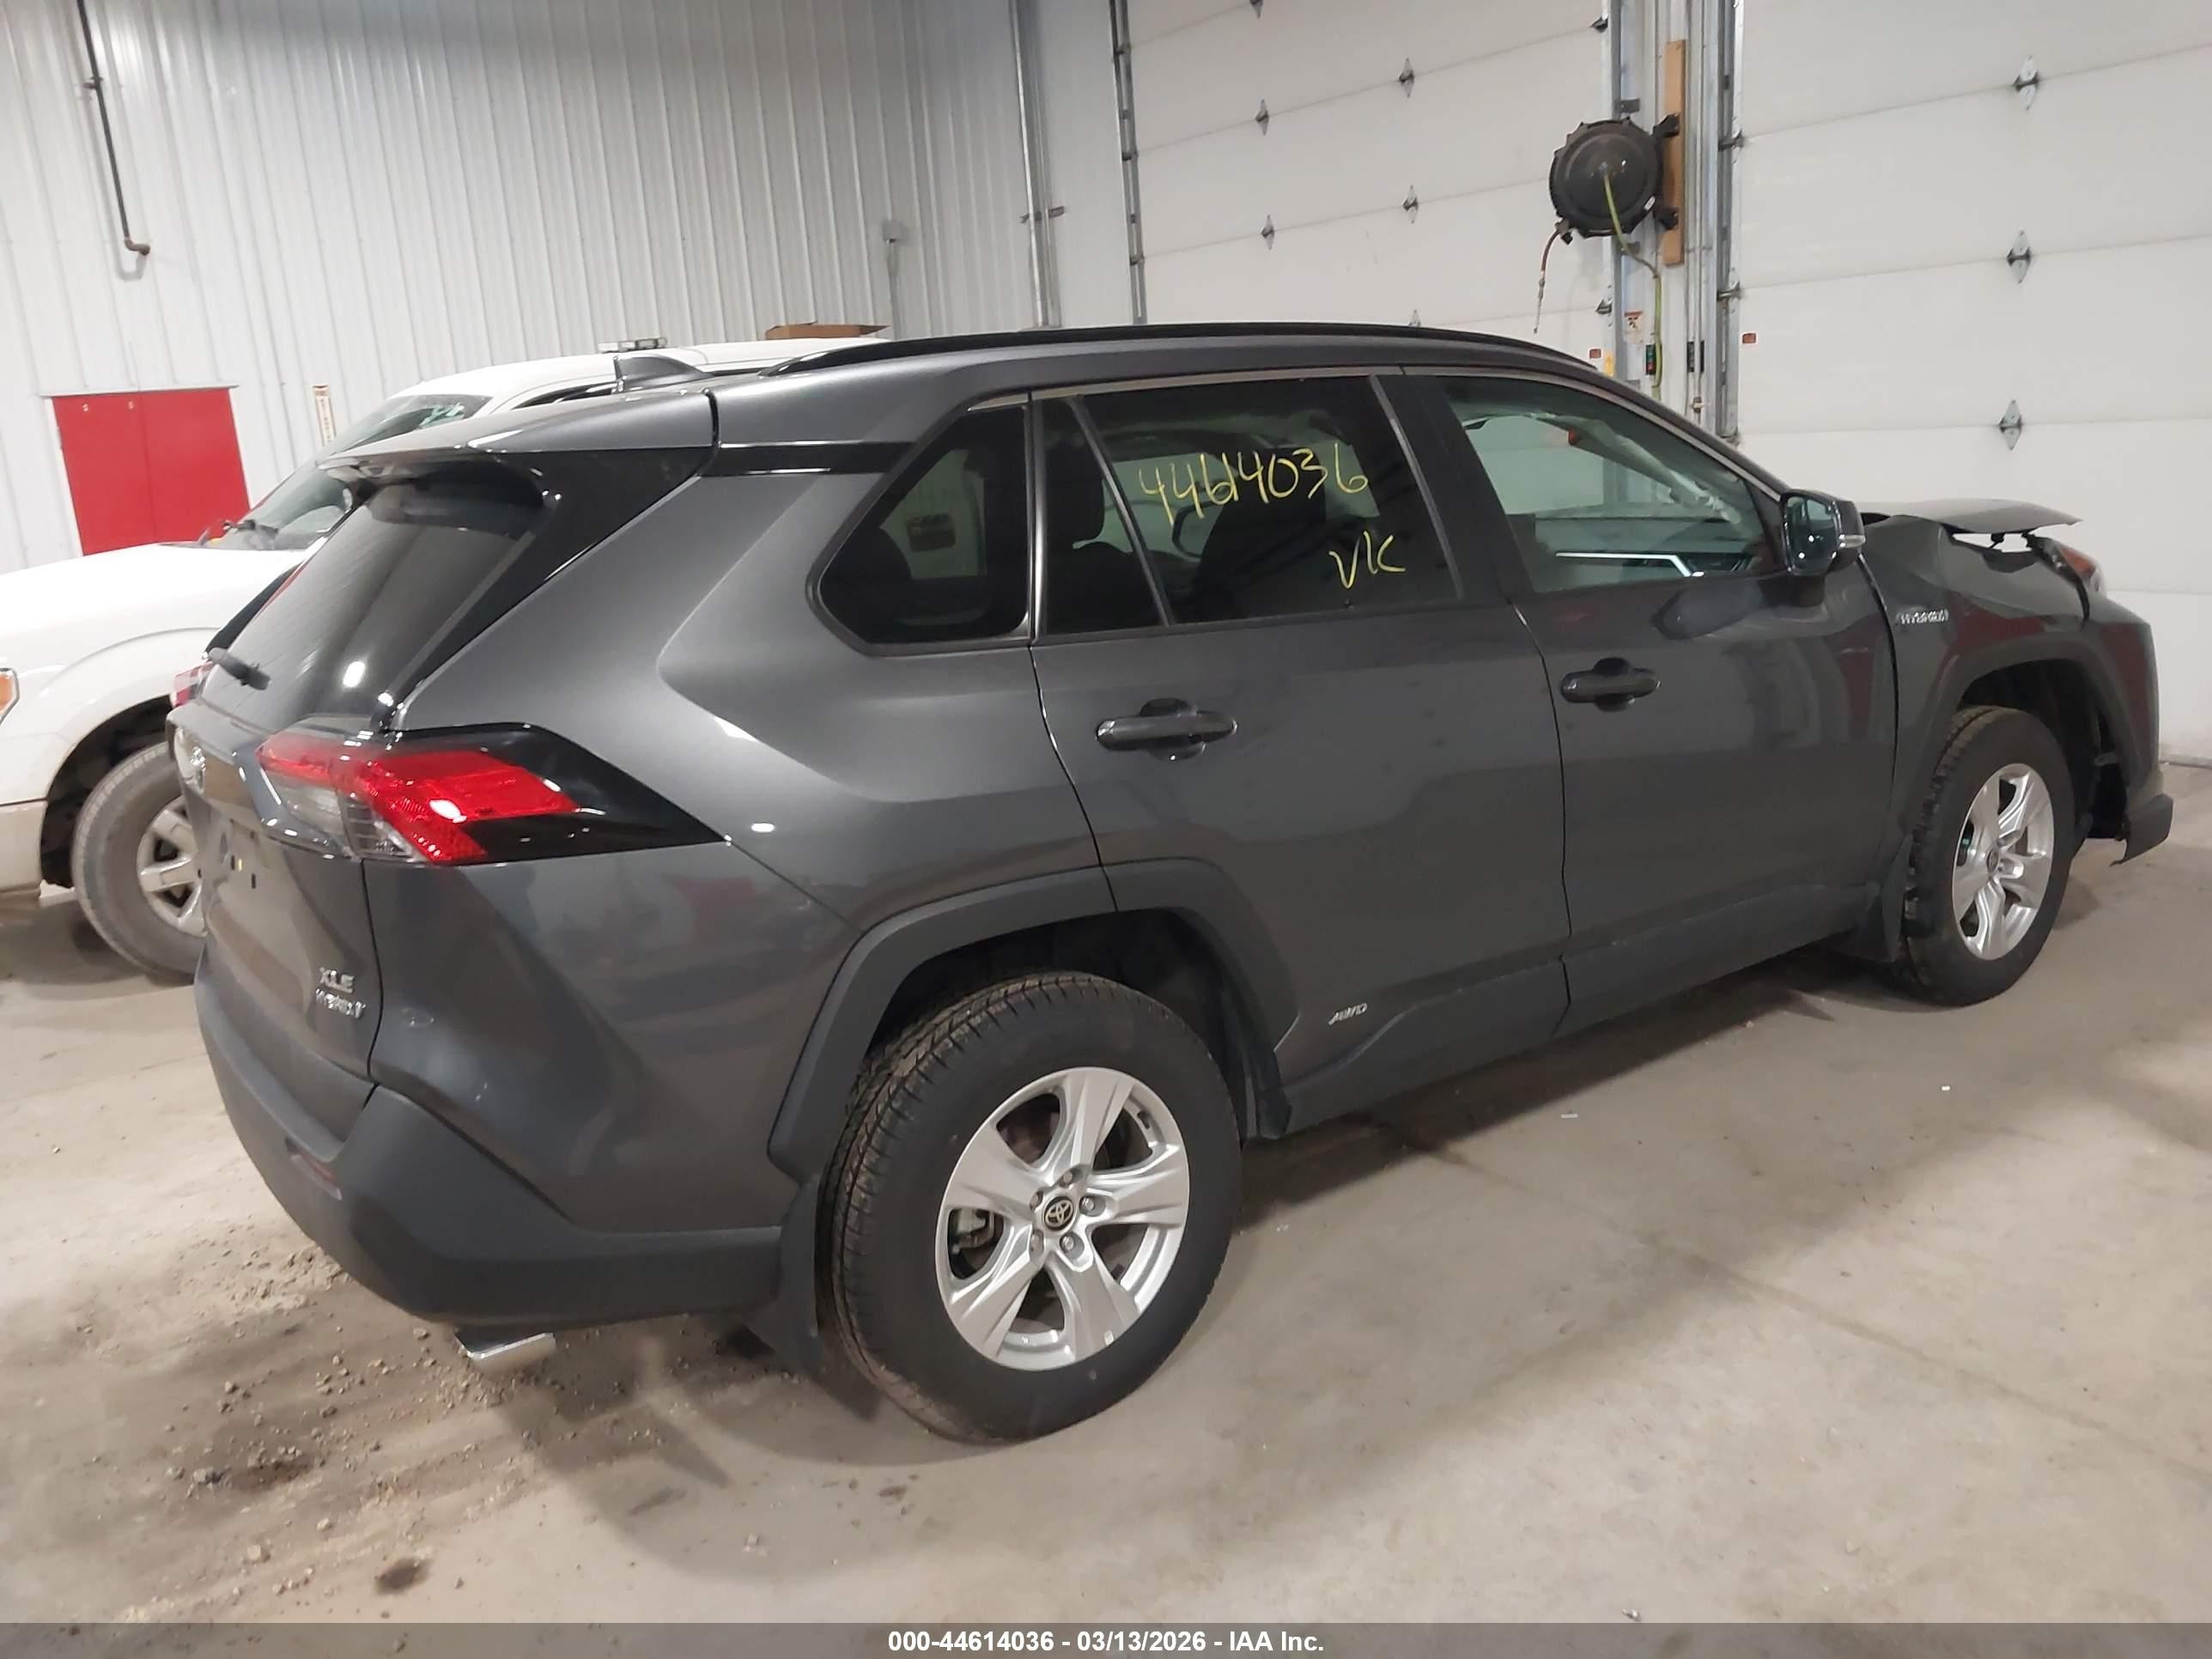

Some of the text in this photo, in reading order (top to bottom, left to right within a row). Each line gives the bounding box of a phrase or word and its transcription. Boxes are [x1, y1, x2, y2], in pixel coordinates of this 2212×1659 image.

[1139, 442, 1369, 526] 44614036
[319, 967, 353, 994] XLE
[1328, 1002, 1368, 1025] AWD
